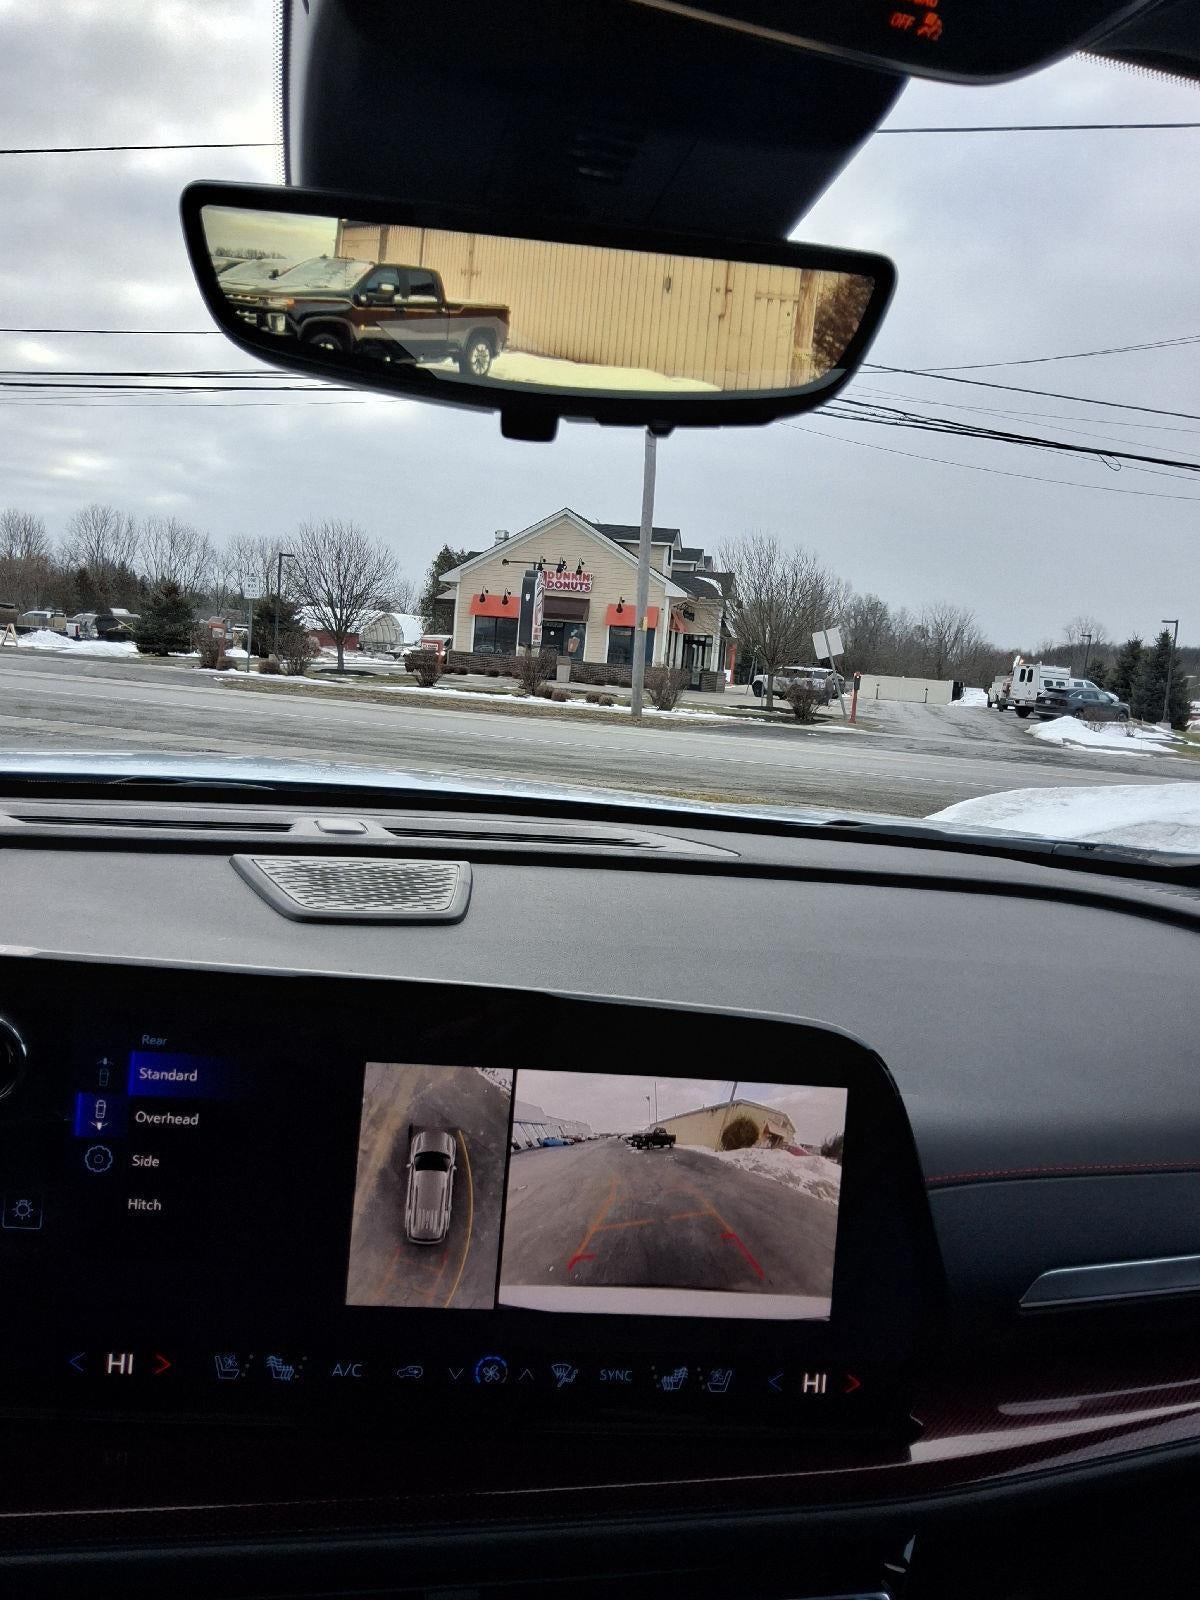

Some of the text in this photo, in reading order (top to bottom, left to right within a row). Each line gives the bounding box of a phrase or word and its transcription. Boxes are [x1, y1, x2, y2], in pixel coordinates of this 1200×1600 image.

[891, 12, 915, 30] OFF
[546, 581, 591, 592] DONUTS
[142, 1034, 168, 1046] Rear
[139, 1067, 198, 1082] Standard
[135, 1111, 199, 1126] Overhead
[132, 1154, 160, 1167] Side
[127, 1198, 162, 1211] Hitch
[107, 1353, 134, 1375] HI
[332, 1363, 363, 1377] A/C
[600, 1369, 633, 1381] SYNC
[803, 1373, 827, 1393] HI
